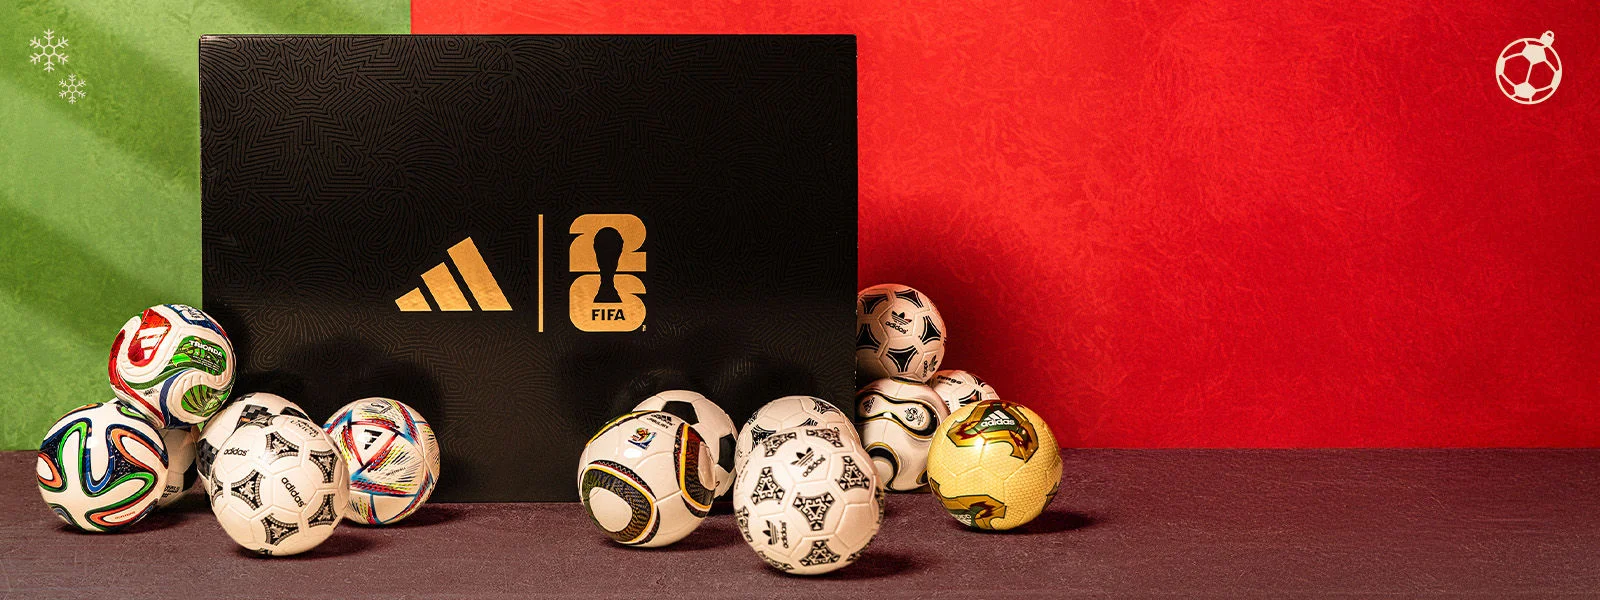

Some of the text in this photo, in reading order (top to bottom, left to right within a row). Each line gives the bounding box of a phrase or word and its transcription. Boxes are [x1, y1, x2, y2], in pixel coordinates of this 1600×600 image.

[591, 308, 626, 321] FIFA
[885, 320, 908, 335] adidas
[188, 339, 223, 358] TRIONDA
[981, 417, 1015, 428] adidas
[223, 446, 249, 457] adidas
[802, 455, 827, 478] adidas
[281, 476, 305, 508] adidas
[780, 521, 790, 549] adidas
